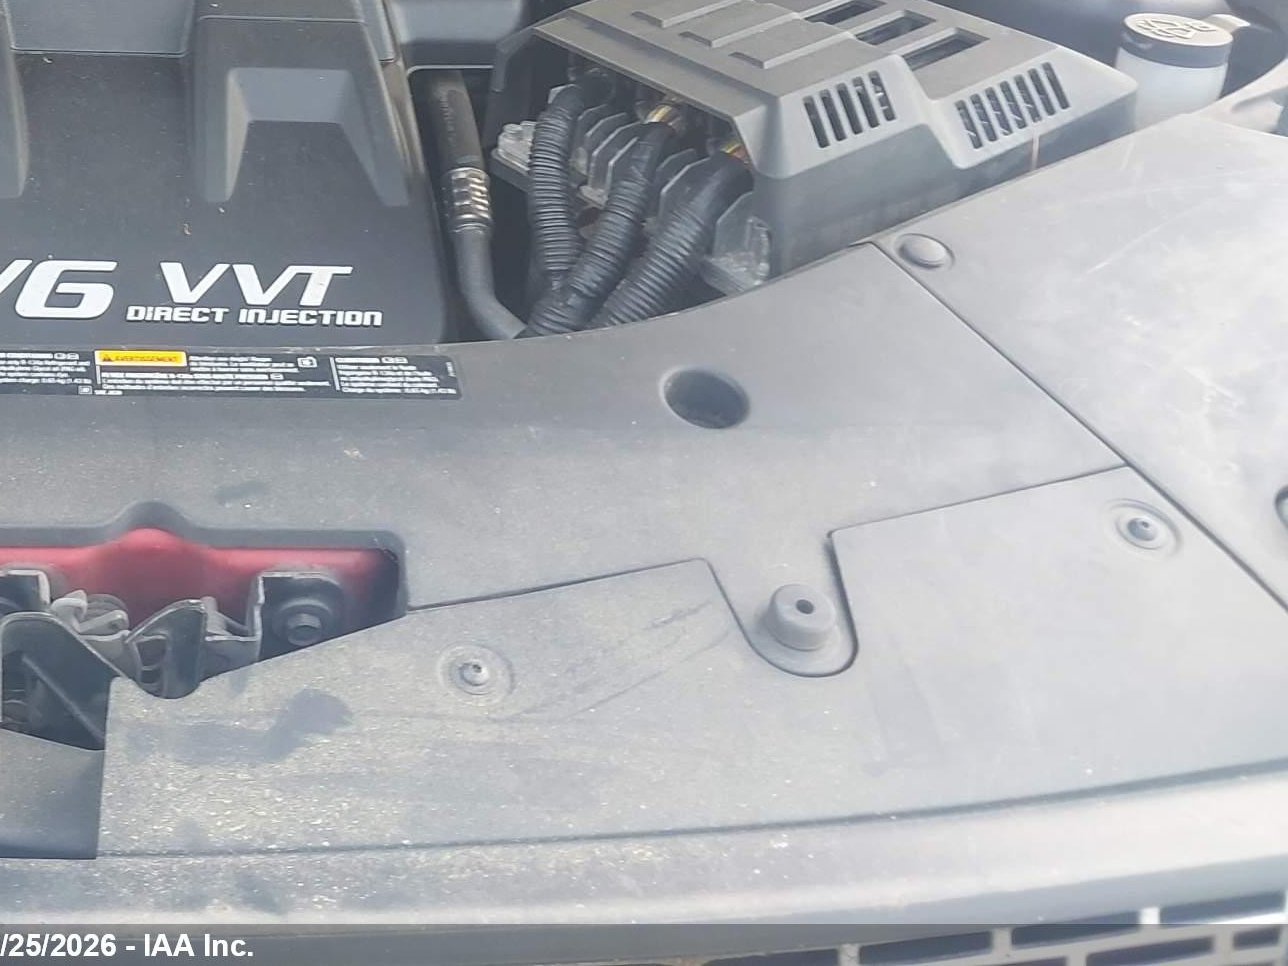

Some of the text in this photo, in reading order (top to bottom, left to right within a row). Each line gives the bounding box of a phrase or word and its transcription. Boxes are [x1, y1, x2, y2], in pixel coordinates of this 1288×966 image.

[160, 262, 354, 306] VVT
[126, 305, 383, 326] DIRECT INJECTION
